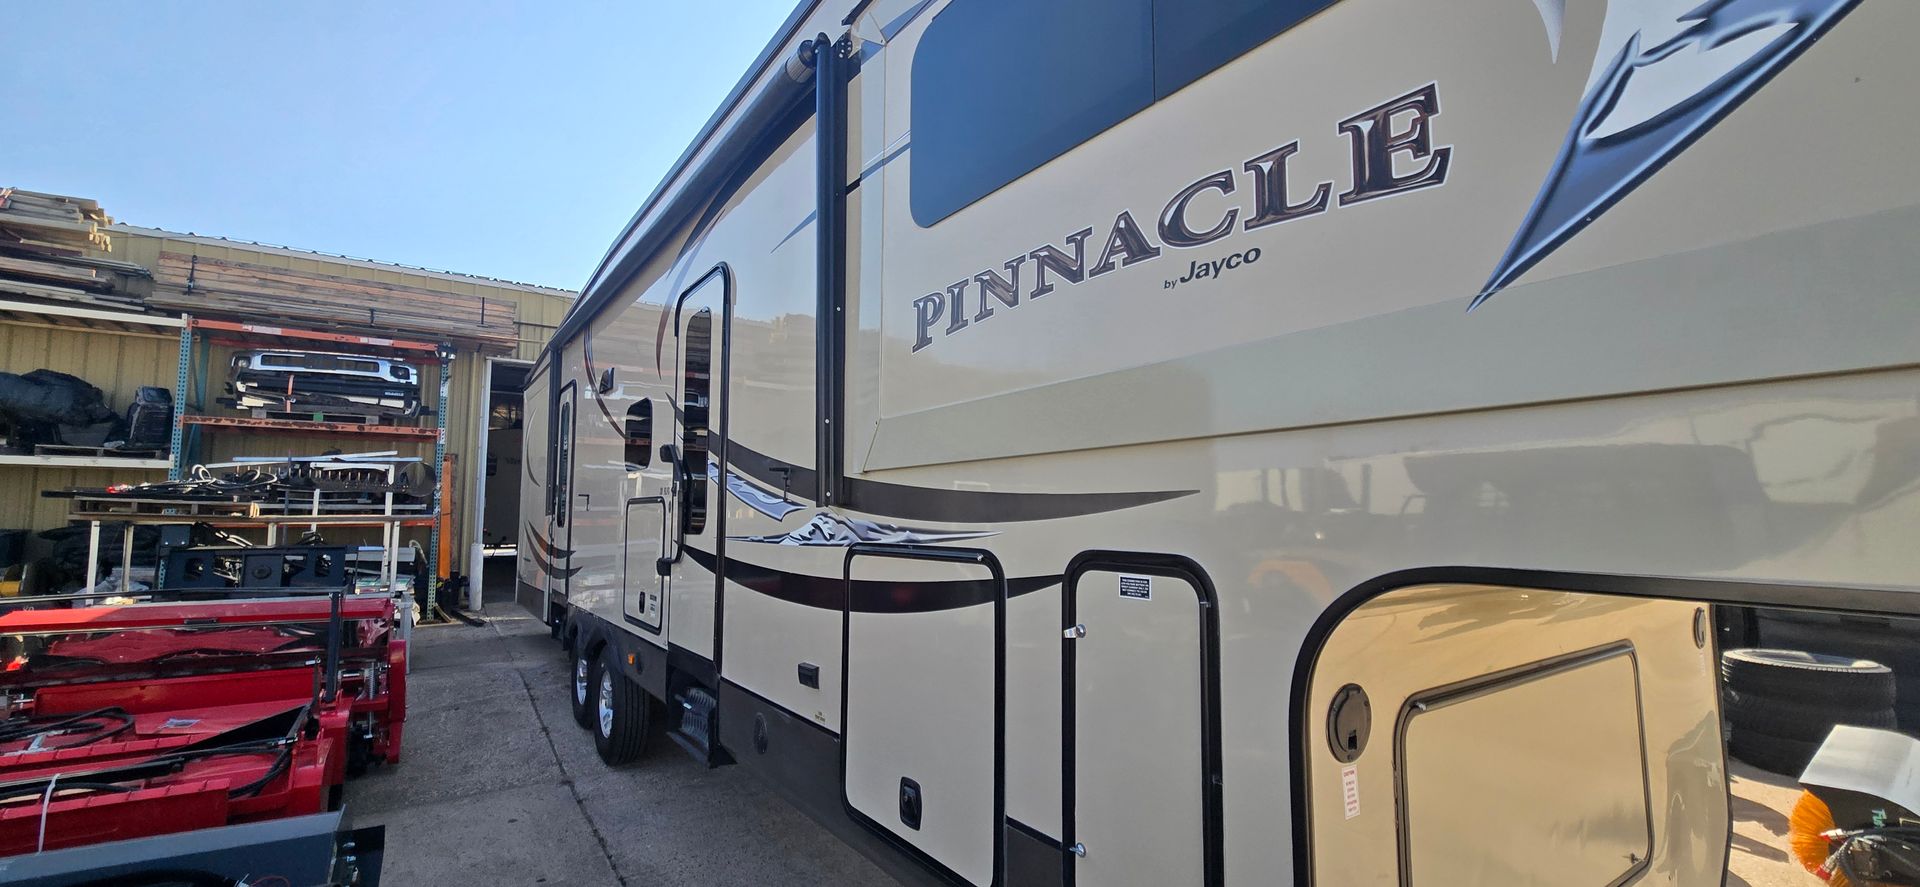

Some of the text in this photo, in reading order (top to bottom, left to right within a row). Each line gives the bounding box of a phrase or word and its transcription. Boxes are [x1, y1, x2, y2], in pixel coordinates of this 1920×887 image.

[912, 80, 1453, 354] PINNACLE
[1163, 248, 1261, 289] by Jayco
